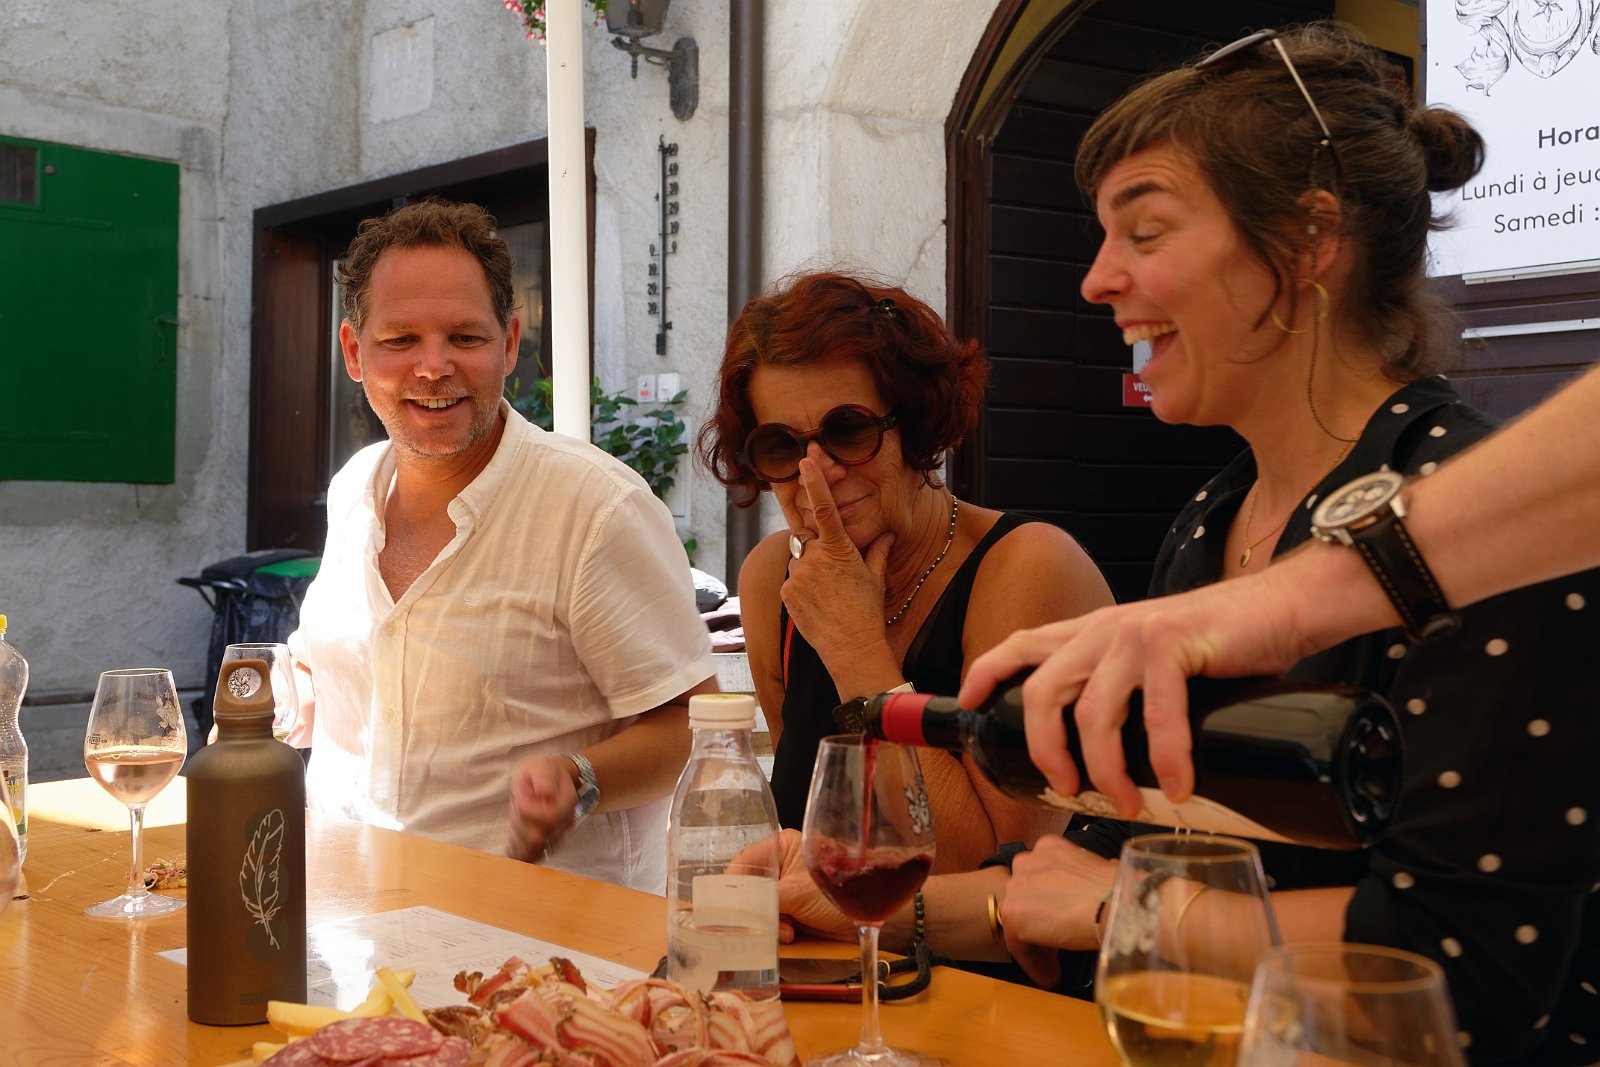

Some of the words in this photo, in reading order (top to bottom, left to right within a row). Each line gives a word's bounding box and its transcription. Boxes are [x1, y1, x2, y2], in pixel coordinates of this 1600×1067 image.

[1538, 126, 1600, 149] Hora
[1462, 174, 1524, 201] Lundi
[1533, 171, 1547, 190] à
[1494, 204, 1583, 234] Samedi
